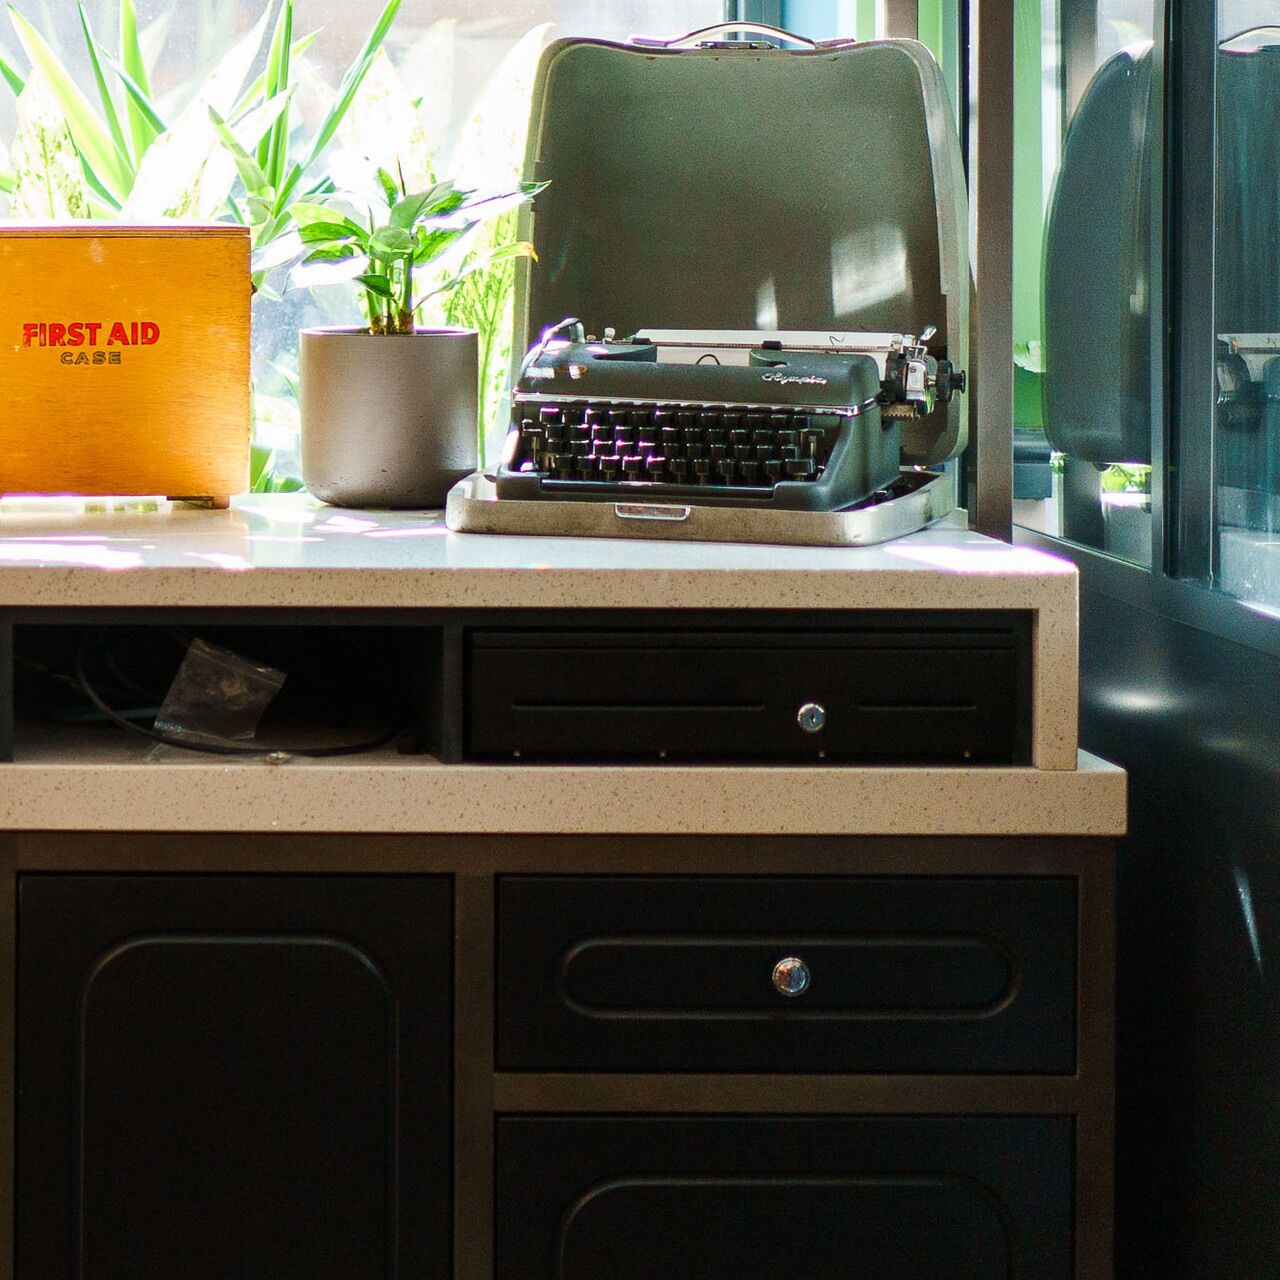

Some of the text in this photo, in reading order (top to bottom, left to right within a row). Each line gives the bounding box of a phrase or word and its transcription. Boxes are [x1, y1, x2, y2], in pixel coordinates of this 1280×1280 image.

[23, 322, 161, 347] FIRST AID
[60, 351, 122, 365] CASE
[762, 372, 828, 385] Olympia
